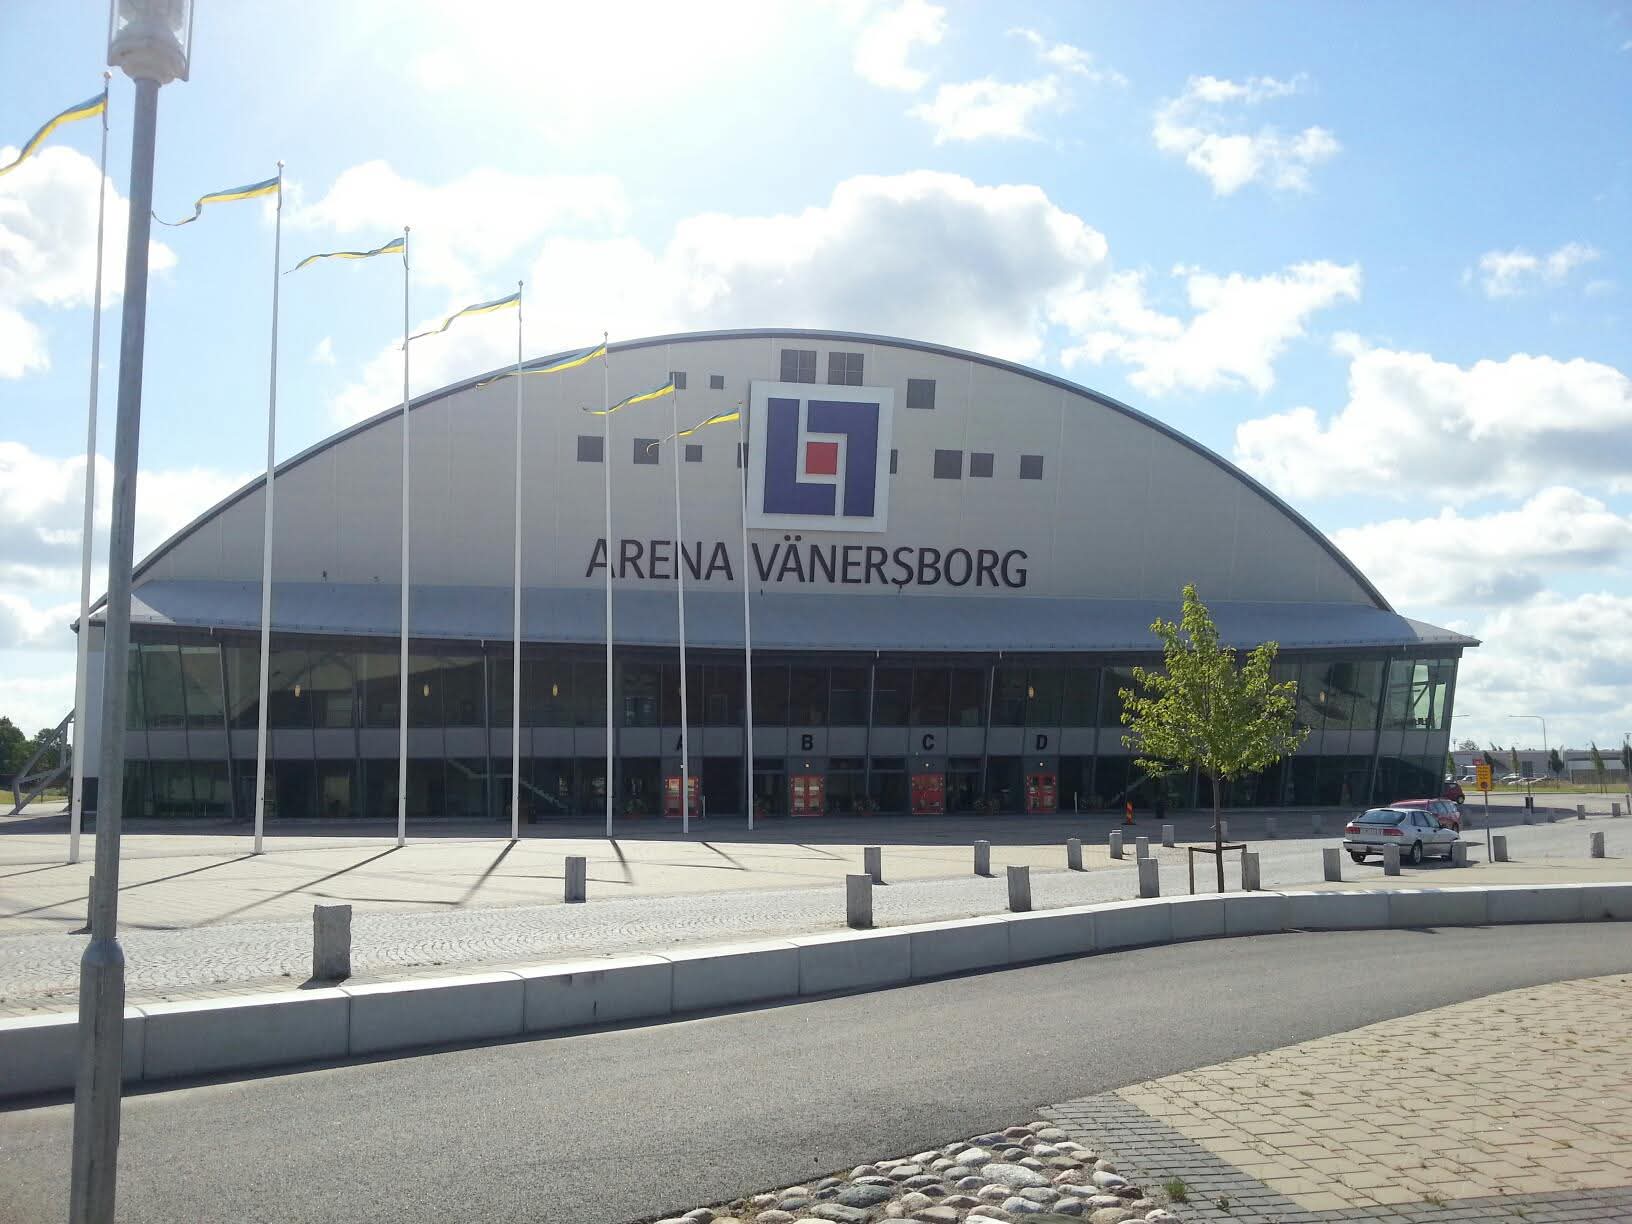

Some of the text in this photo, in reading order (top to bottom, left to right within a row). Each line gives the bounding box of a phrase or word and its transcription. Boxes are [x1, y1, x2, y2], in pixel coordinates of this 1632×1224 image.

[586, 535, 1028, 587] ARENA VÄNERSBORG
[801, 734, 813, 751] B
[922, 734, 935, 750] C
[1036, 734, 1048, 750] D
